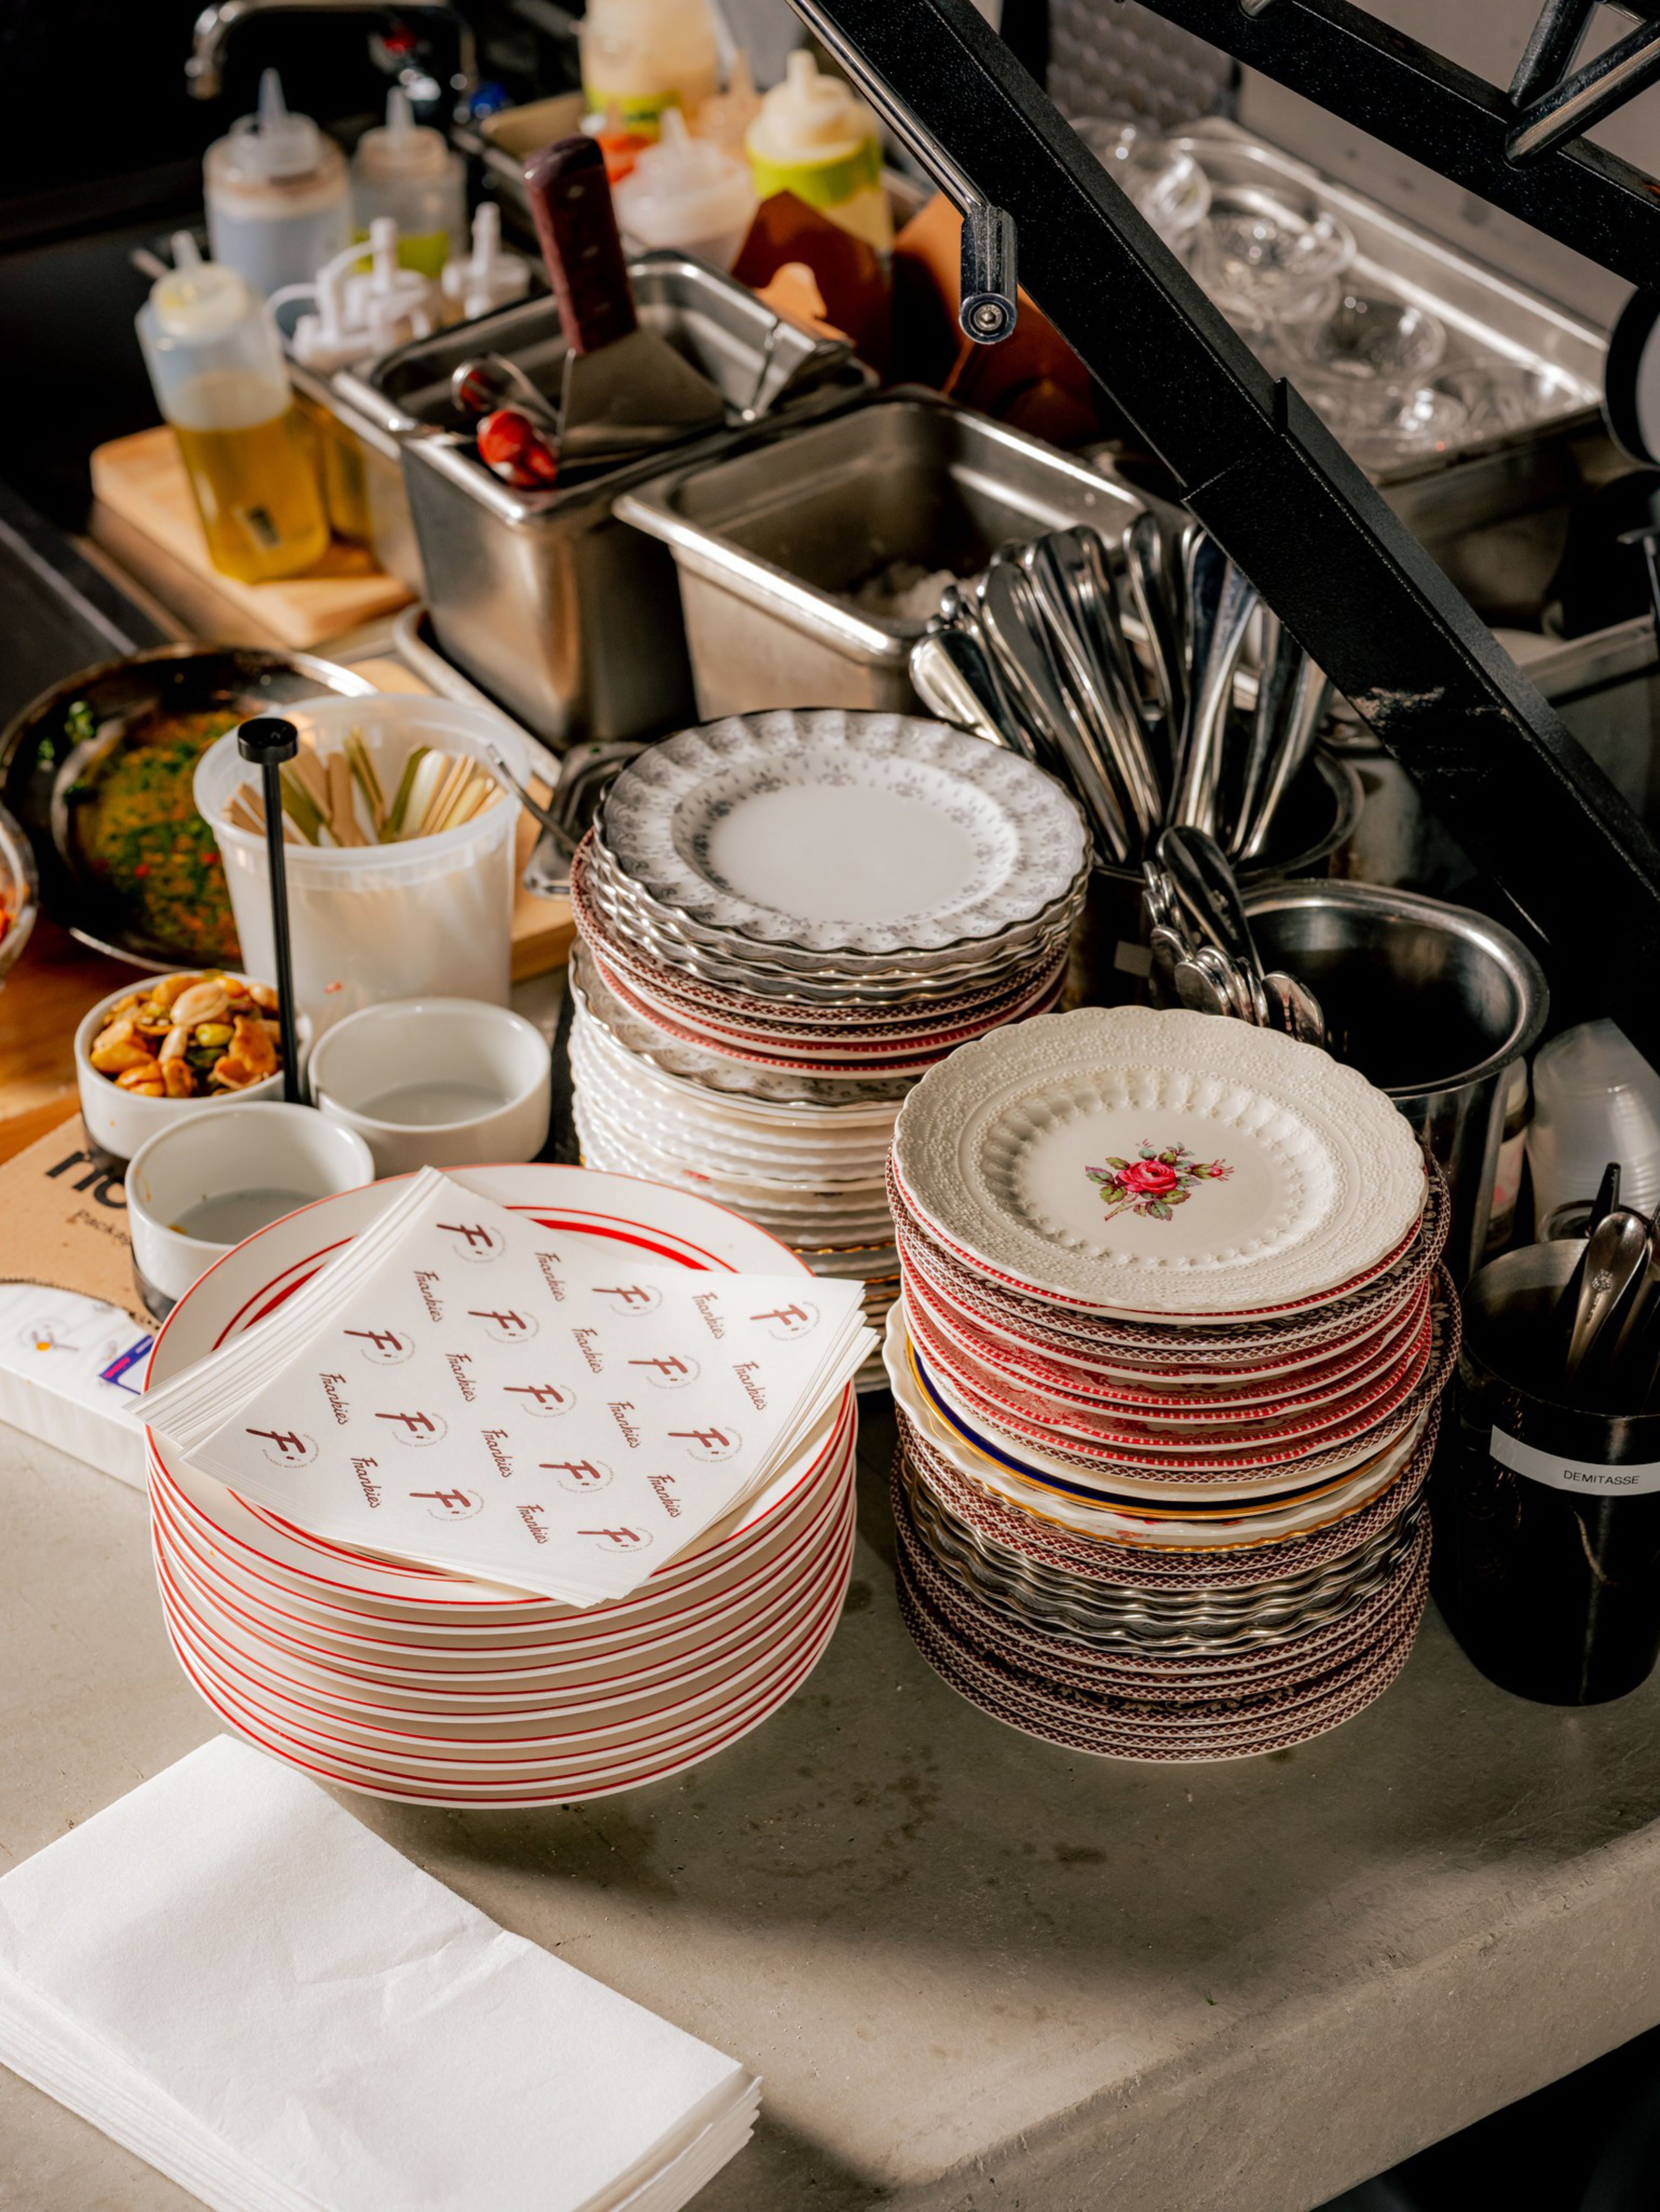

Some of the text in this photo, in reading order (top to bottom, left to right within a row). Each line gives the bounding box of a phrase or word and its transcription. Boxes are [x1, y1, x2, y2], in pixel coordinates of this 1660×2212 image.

[435, 1223, 494, 1248] F
[591, 1285, 651, 1304] F
[467, 1310, 527, 1330] F
[750, 1304, 808, 1326] F
[343, 1329, 403, 1351] F
[628, 1356, 688, 1375] F
[503, 1384, 564, 1403] F
[374, 1412, 436, 1432] F
[245, 1428, 306, 1454] F
[667, 1427, 730, 1448] F
[538, 1460, 601, 1480] F
[1563, 1470, 1640, 1485] DEMITASSE
[409, 1488, 472, 1508] F
[576, 1527, 641, 1543] F
